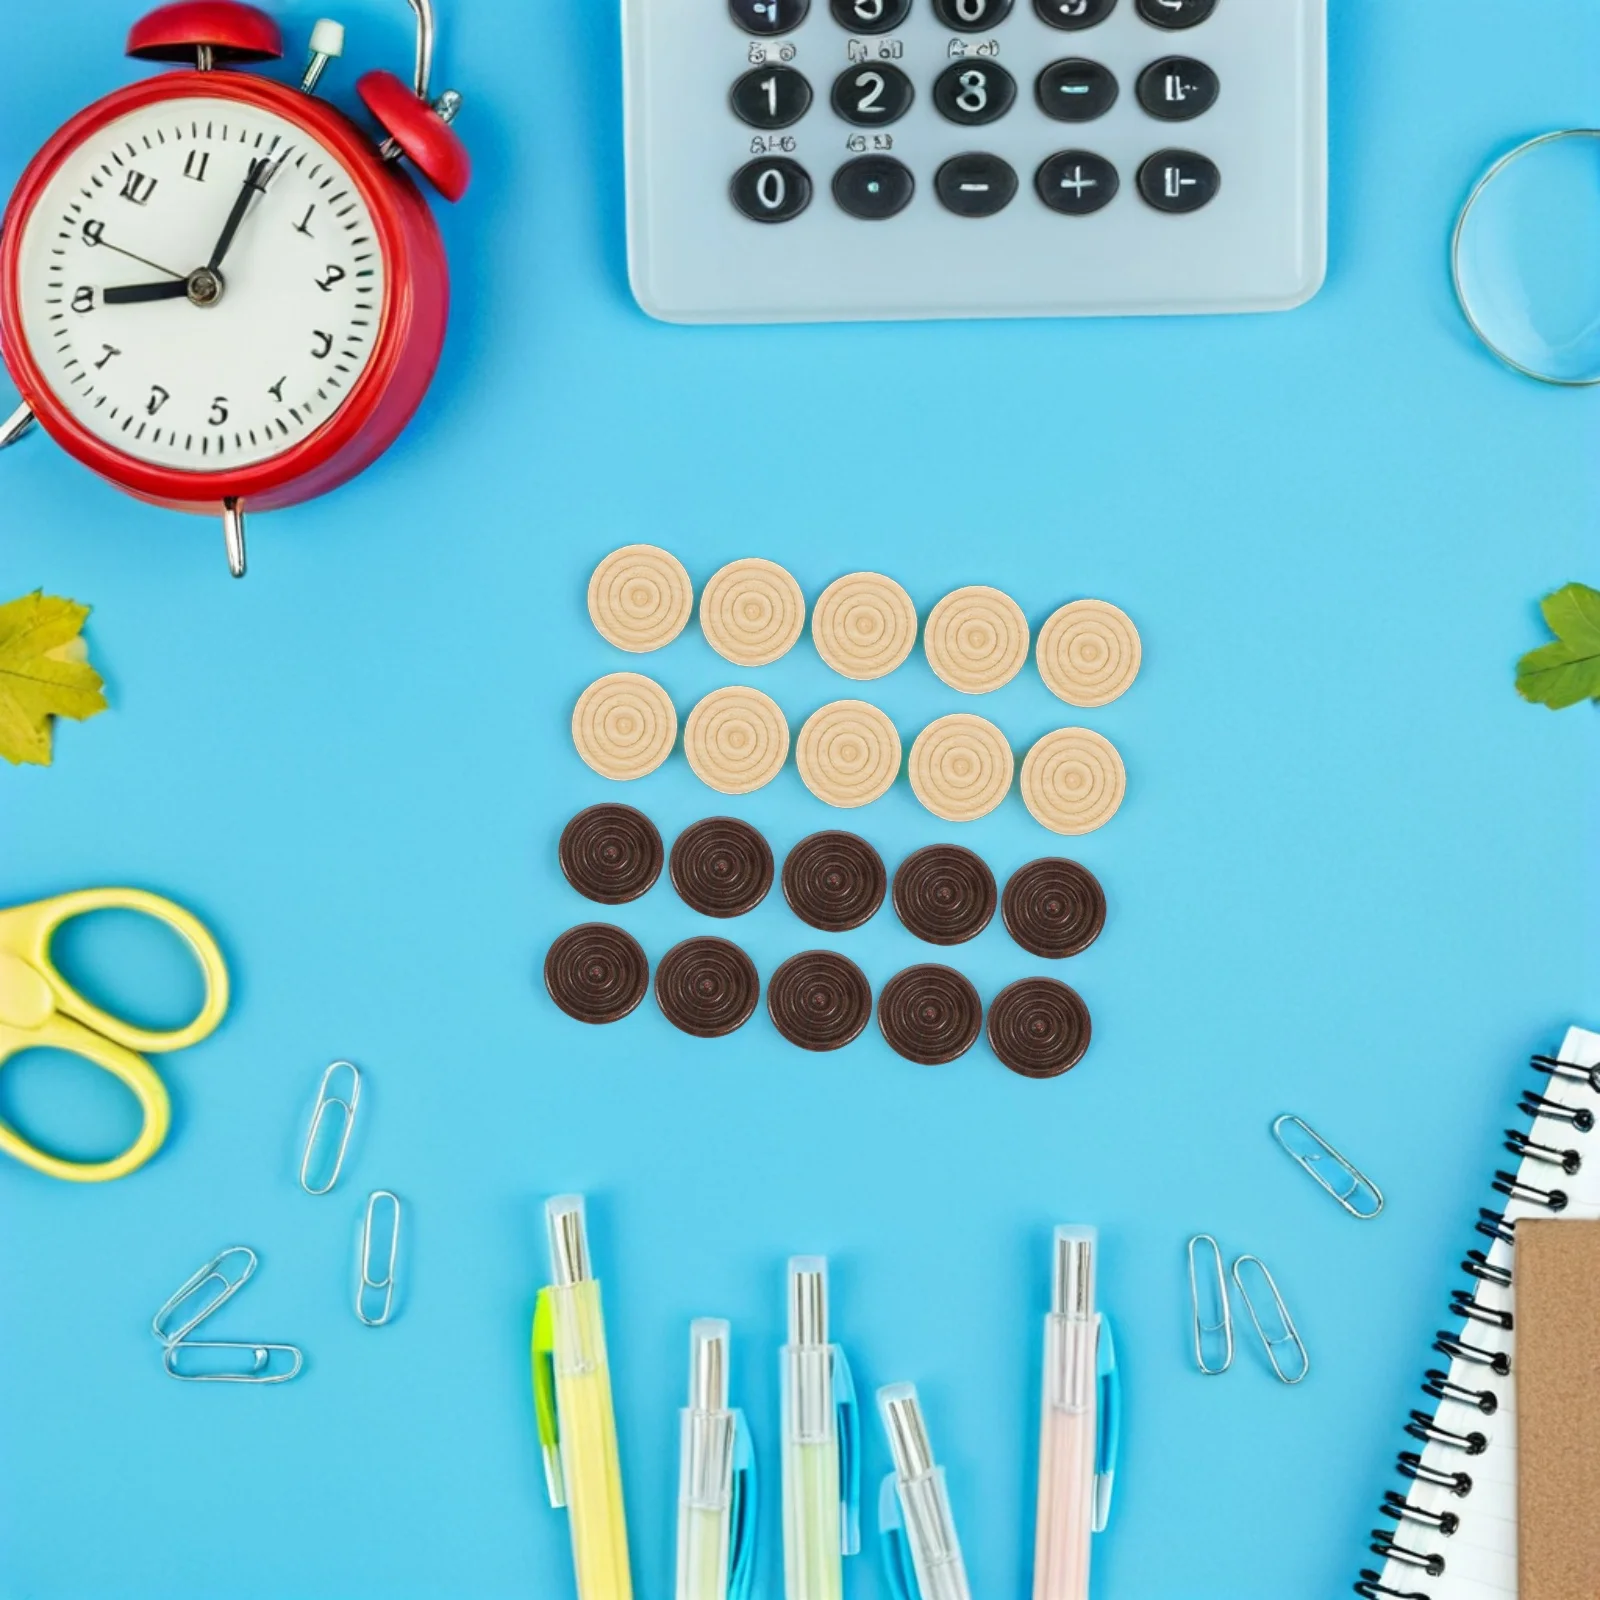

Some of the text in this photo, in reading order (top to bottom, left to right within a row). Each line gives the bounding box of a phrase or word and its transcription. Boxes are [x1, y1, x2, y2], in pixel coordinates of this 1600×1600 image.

[761, 77, 777, 116] 1
[855, 71, 886, 113] 2
[756, 169, 785, 209] 0
[208, 396, 229, 426] 5
